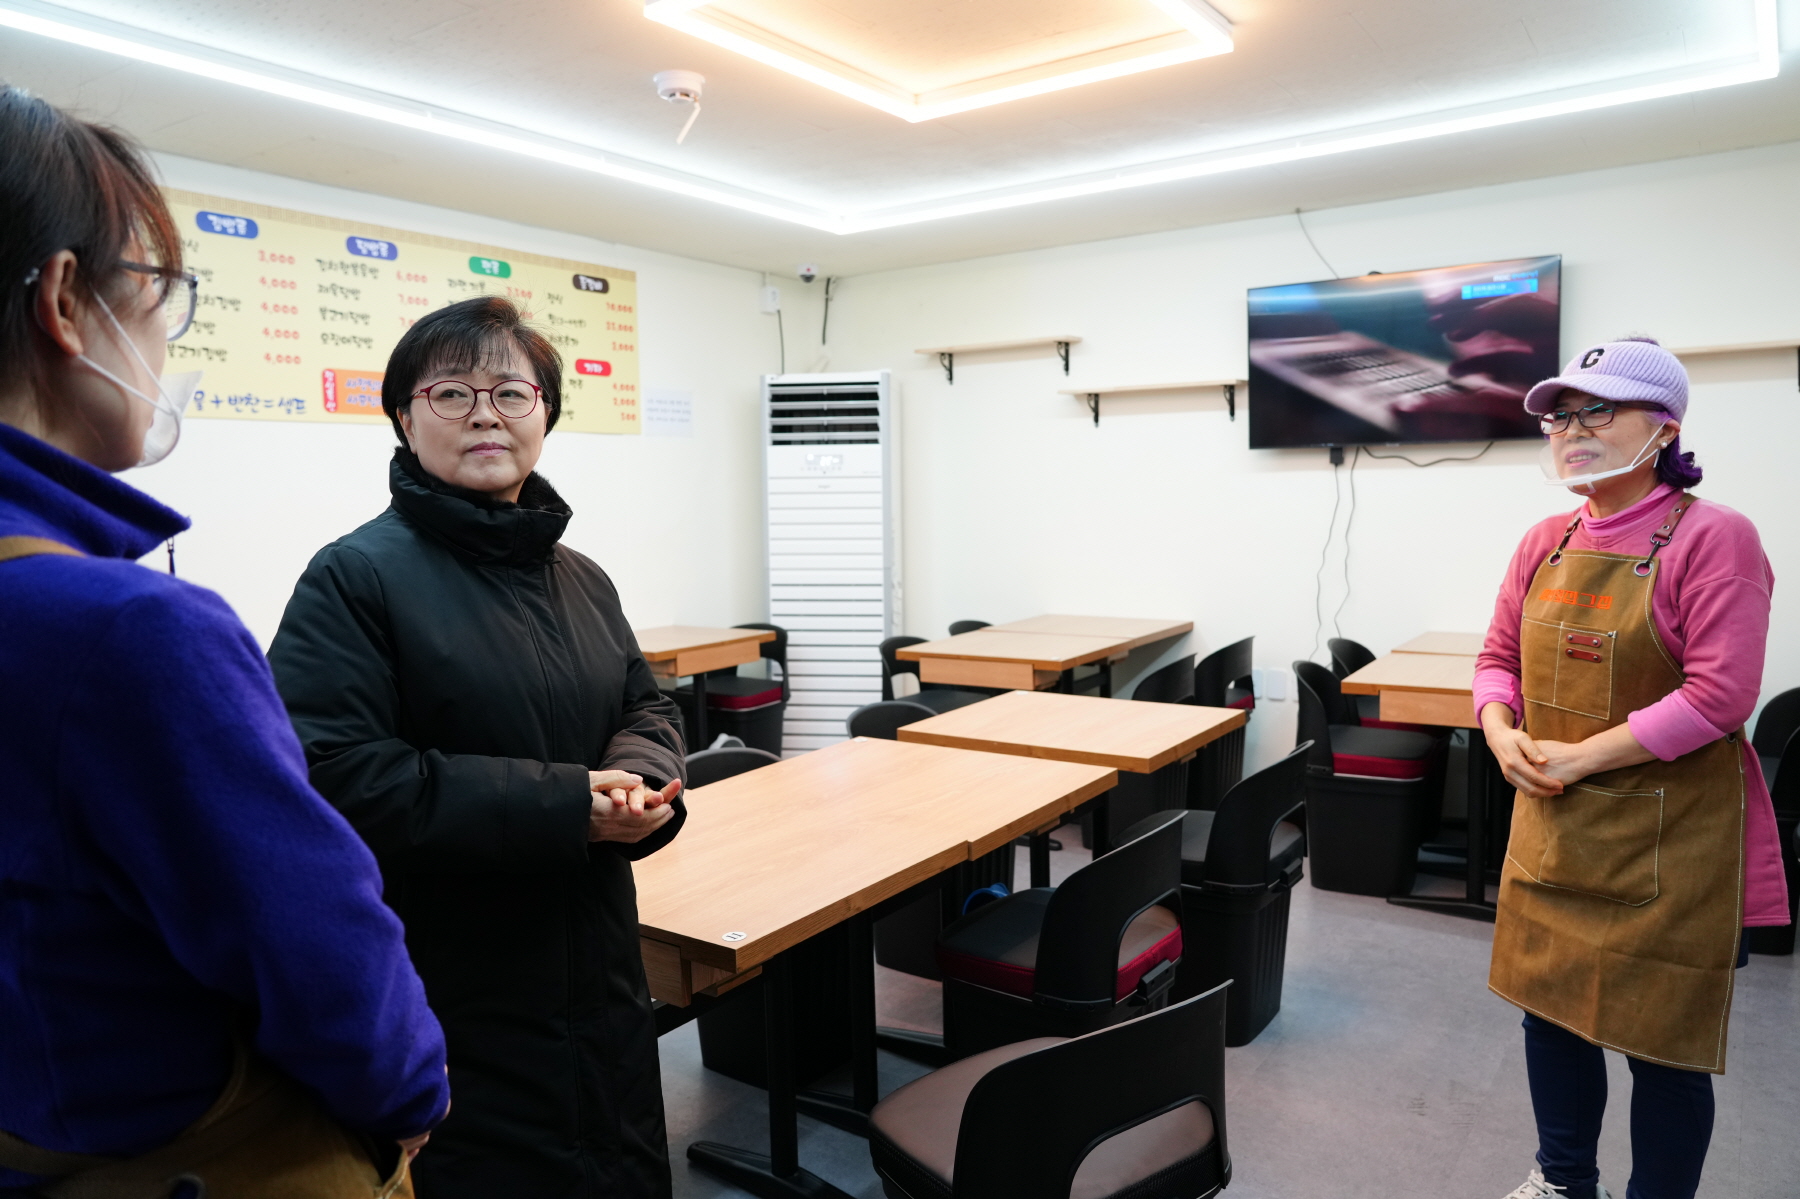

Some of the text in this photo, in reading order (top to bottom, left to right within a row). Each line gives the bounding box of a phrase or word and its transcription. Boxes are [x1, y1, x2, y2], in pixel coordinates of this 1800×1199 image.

[259, 276, 298, 290] 4,000
[260, 302, 299, 315] 4,000
[262, 327, 300, 340] 4,000
[264, 352, 302, 365] 4,000
[1580, 348, 1605, 370] C
[228, 393, 260, 413] 반찬
